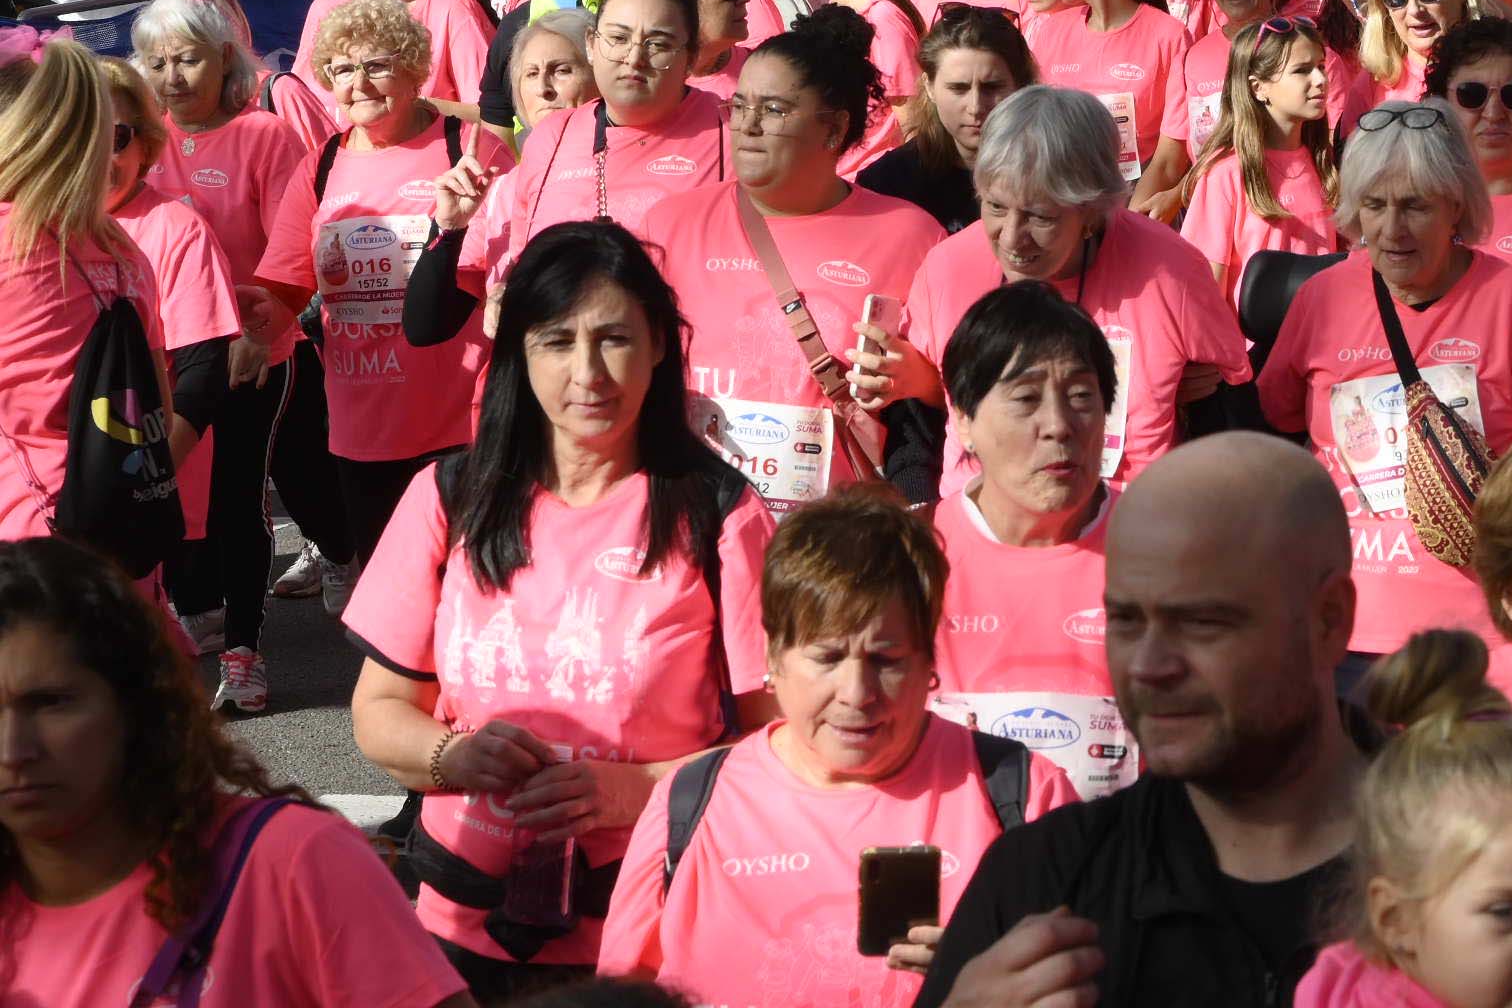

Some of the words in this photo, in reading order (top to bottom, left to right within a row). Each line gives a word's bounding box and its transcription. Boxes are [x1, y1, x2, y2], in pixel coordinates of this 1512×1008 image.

[350, 234, 393, 245] ASTURIANA
[351, 257, 392, 275] 016
[820, 263, 867, 284] ASTURIANA
[357, 278, 389, 289] 15752
[329, 321, 402, 340] DORS
[335, 348, 402, 375] SUMA
[694, 366, 736, 399] TU
[796, 424, 823, 434] SUMA
[729, 454, 778, 476] 016
[1359, 469, 1397, 482] CARRERA
[1397, 468, 1406, 476] D
[765, 501, 789, 510] UJER
[999, 719, 1074, 741] ASTURIANA
[487, 824, 499, 836] DE
[722, 852, 810, 877] OYSHO
